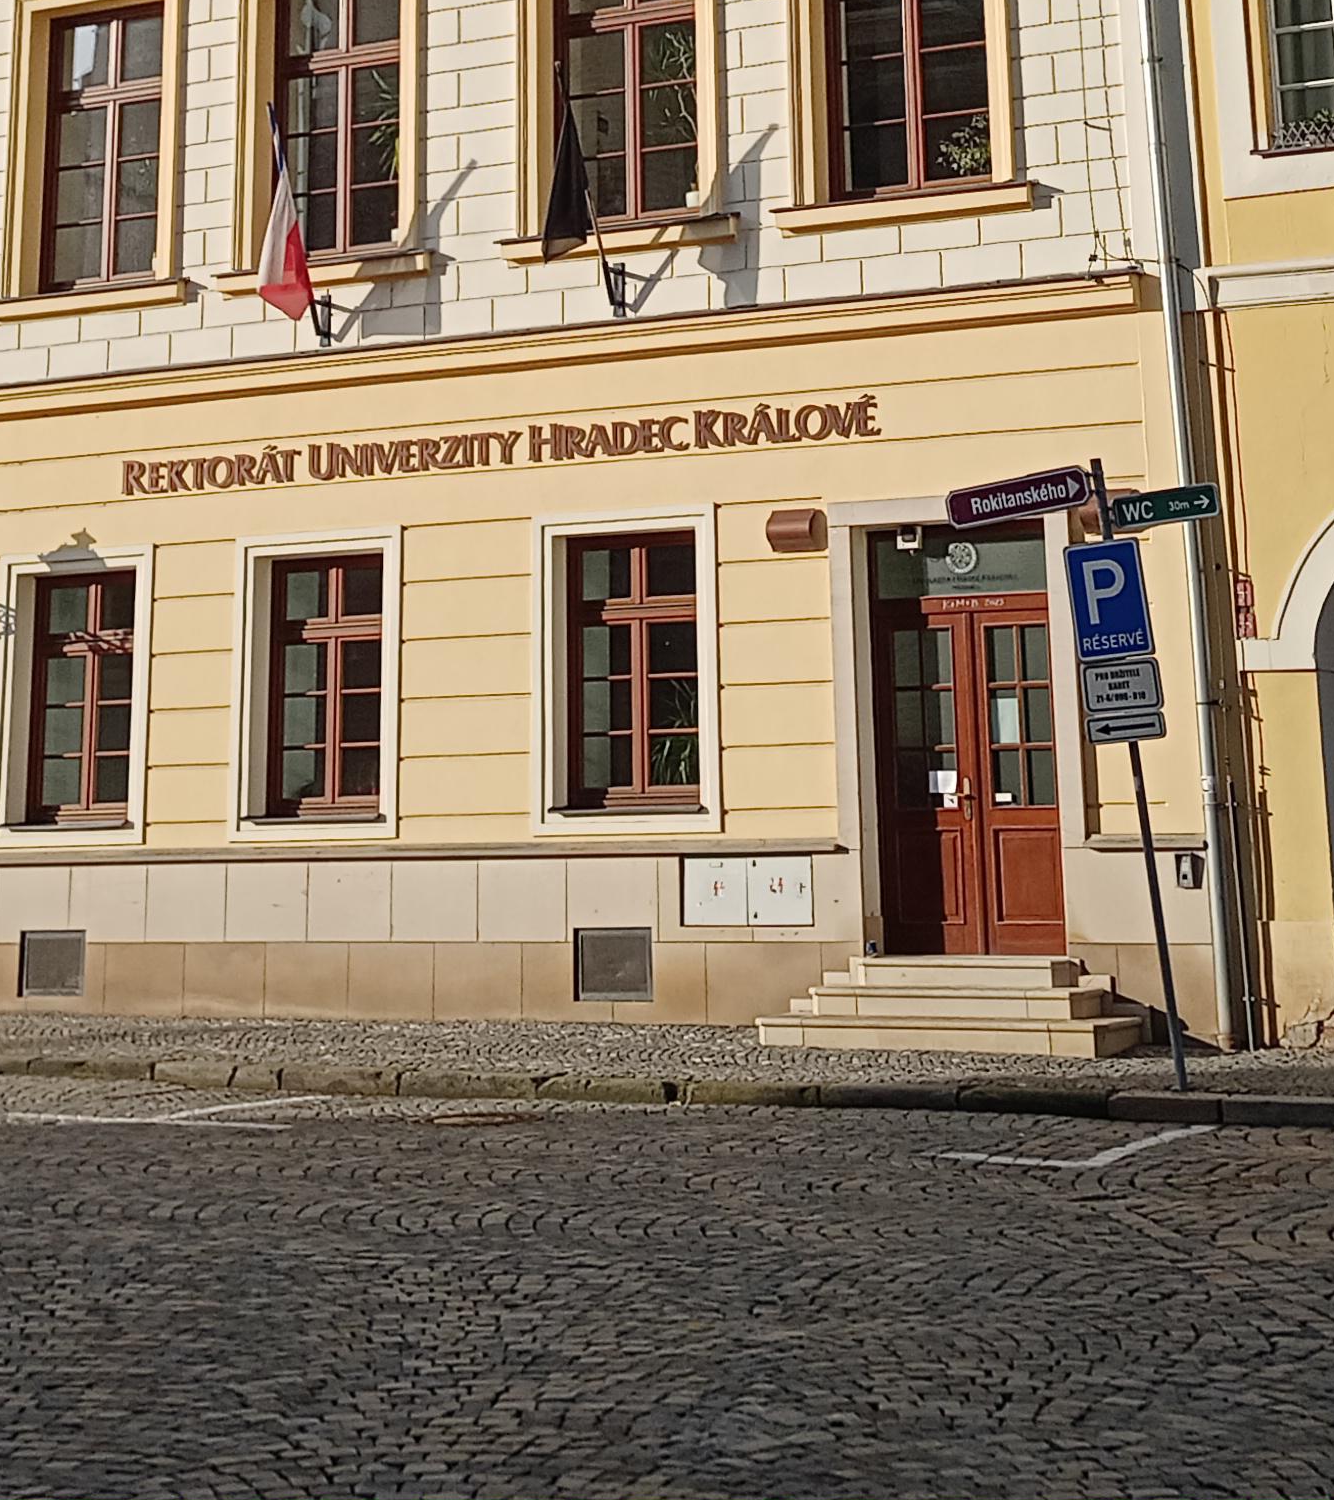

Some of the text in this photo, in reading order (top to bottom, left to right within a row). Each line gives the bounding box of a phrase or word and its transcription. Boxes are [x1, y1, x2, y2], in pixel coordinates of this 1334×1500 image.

[121, 393, 882, 496] REKTORÁT UNIVERZITY HRADEC KRÁLOVÉ
[970, 482, 1067, 516] Rokitanského
[1122, 500, 1190, 522] WC 30m
[1082, 559, 1125, 625] P
[1083, 628, 1145, 651] RÉSERVÉ
